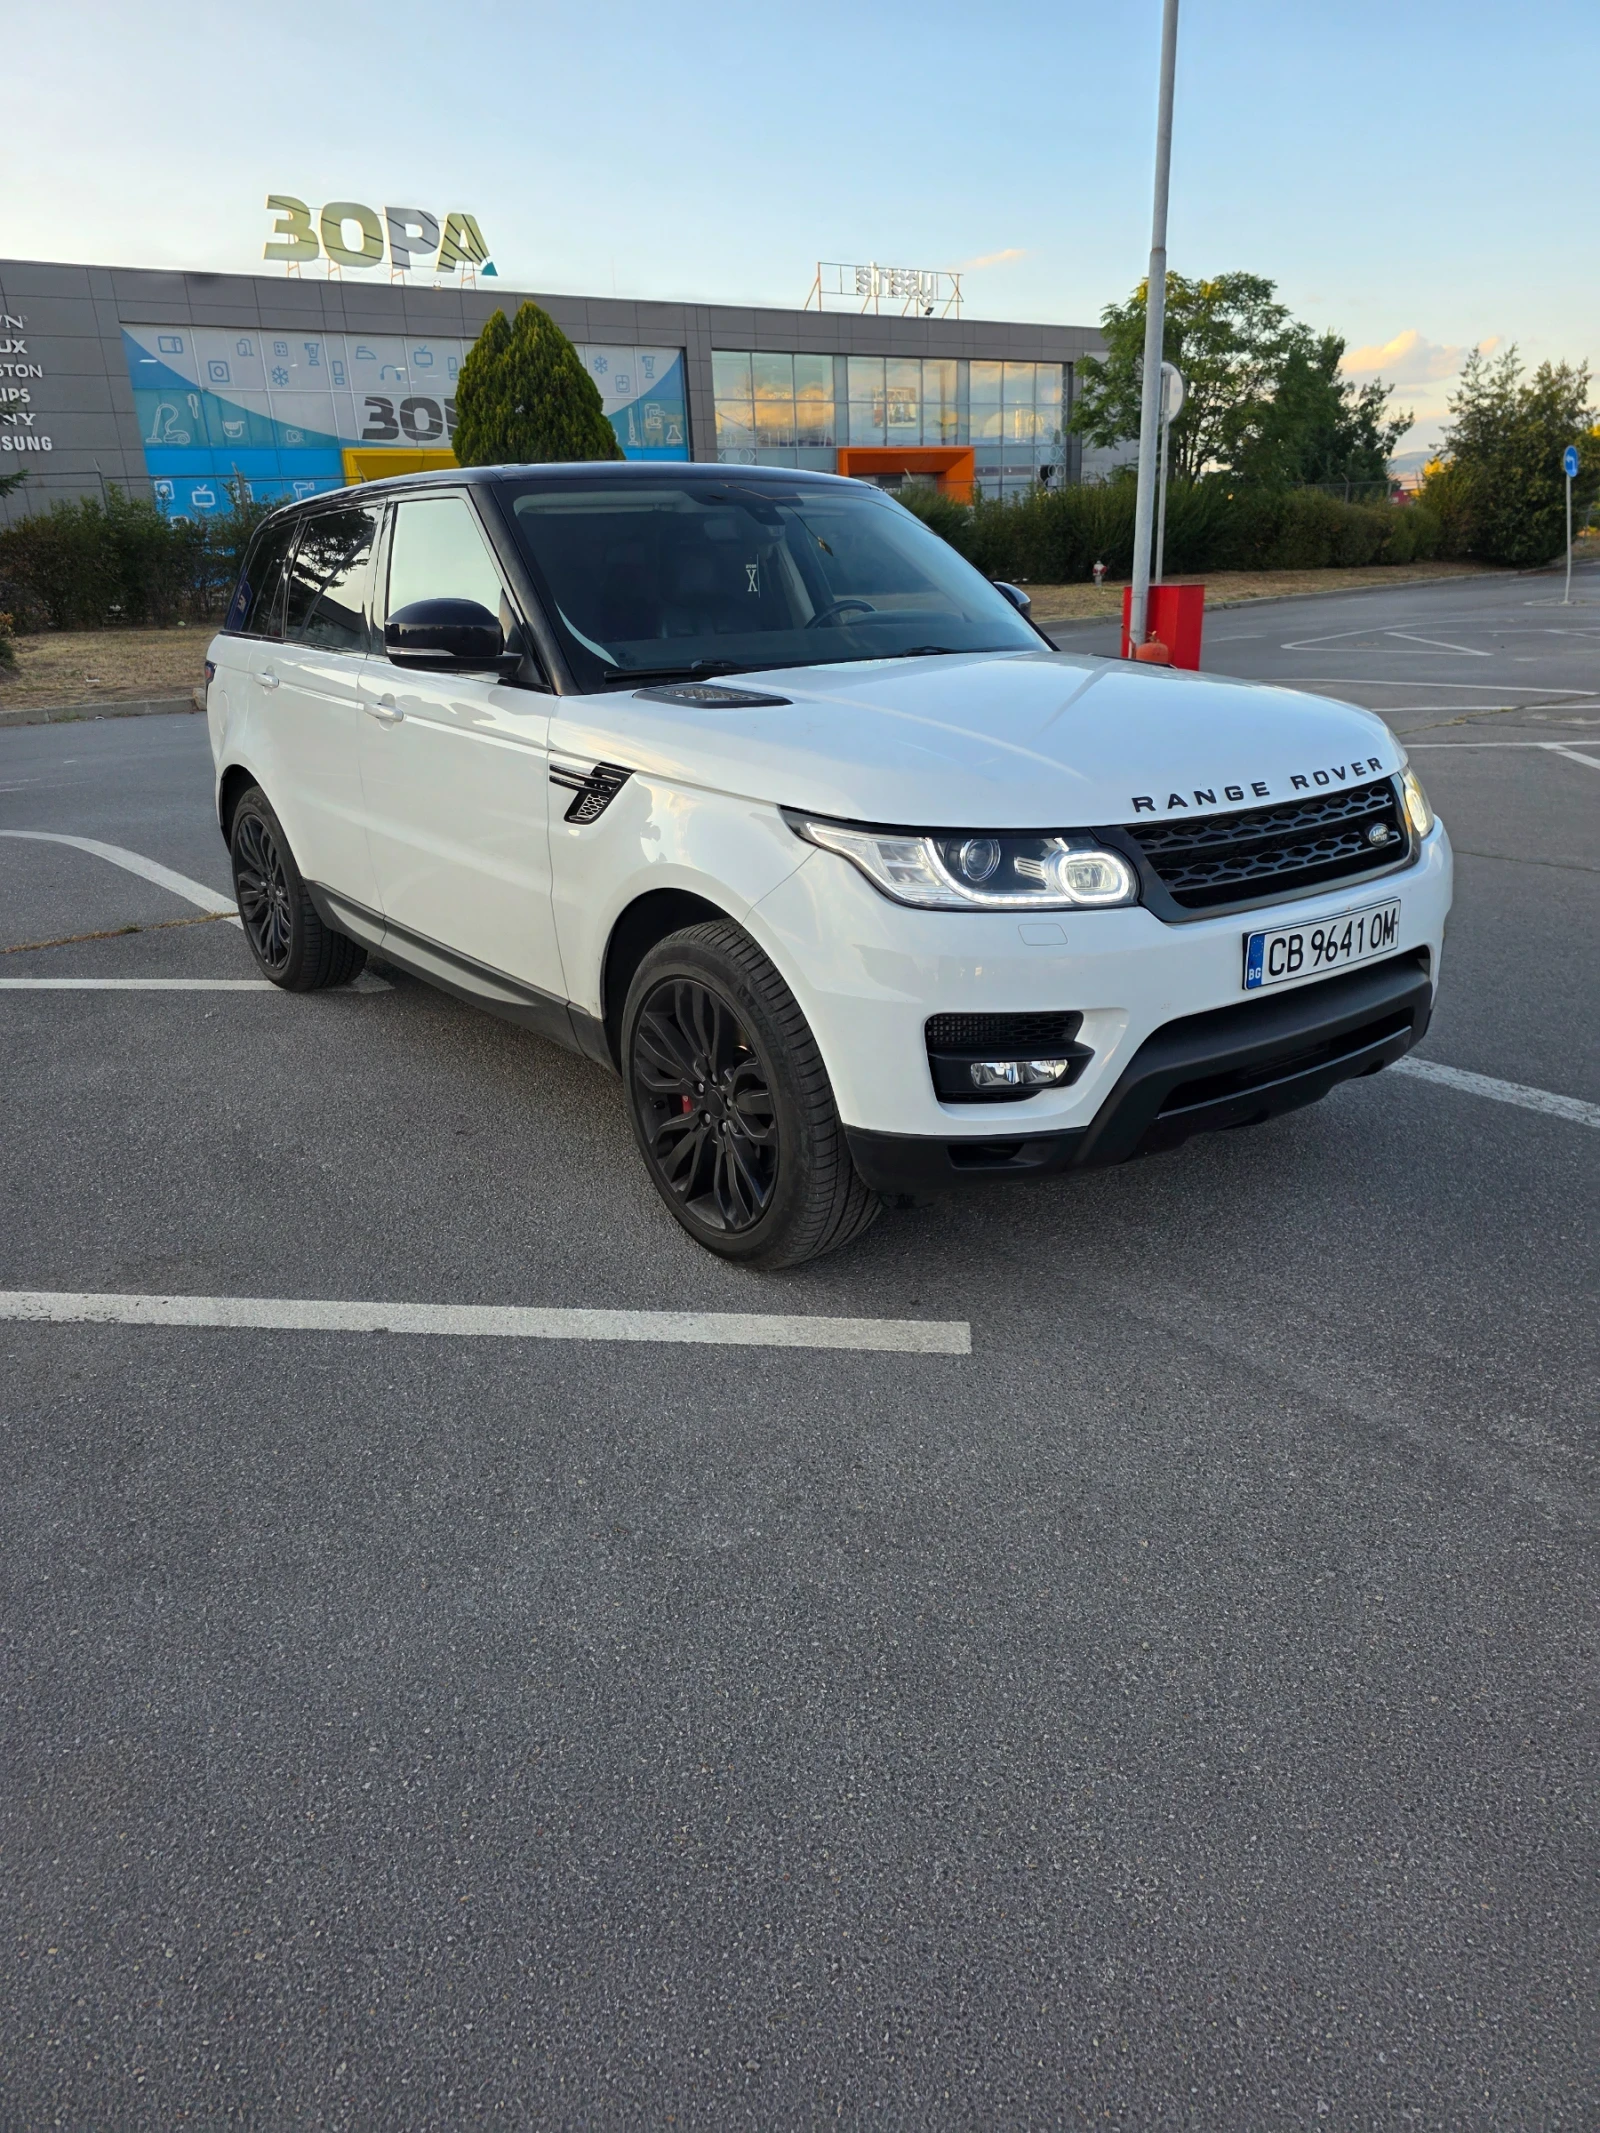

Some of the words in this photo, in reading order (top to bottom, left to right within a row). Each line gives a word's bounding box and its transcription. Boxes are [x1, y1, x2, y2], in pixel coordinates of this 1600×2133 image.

[0, 387, 31, 403] IPS
[1131, 781, 1271, 813] RANGE
[1290, 757, 1384, 790] ROVER
[1268, 933, 1304, 977] CB
[1310, 917, 1364, 967] 9641
[1370, 907, 1397, 949] OM
[1248, 967, 1262, 981] BG
